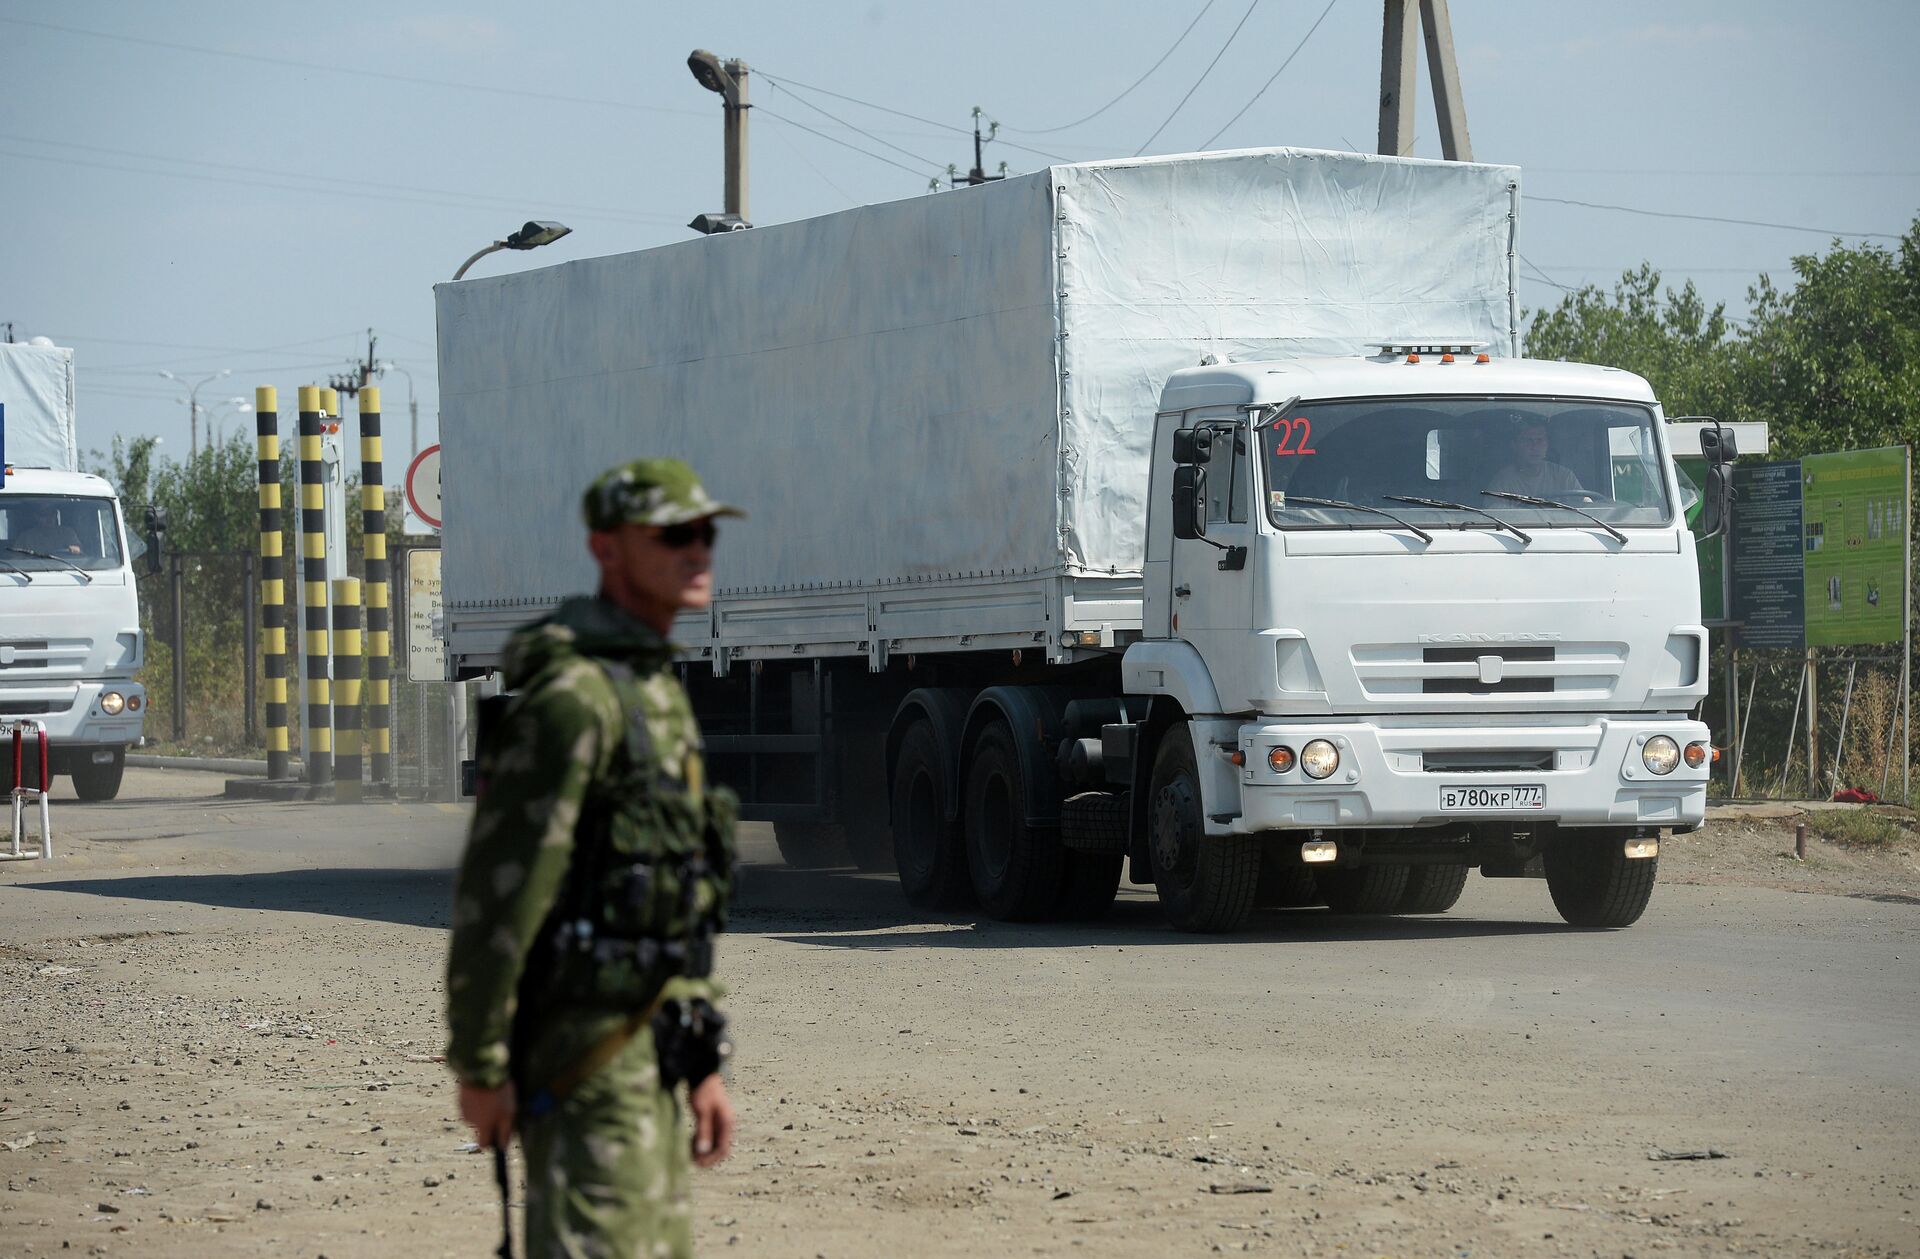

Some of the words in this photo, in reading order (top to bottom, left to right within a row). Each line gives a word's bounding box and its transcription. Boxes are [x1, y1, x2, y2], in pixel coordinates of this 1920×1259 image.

[1273, 417, 1316, 456] 22
[412, 645, 421, 653] Do
[1446, 789, 1510, 807] В780КР
[1513, 788, 1538, 801] 777
